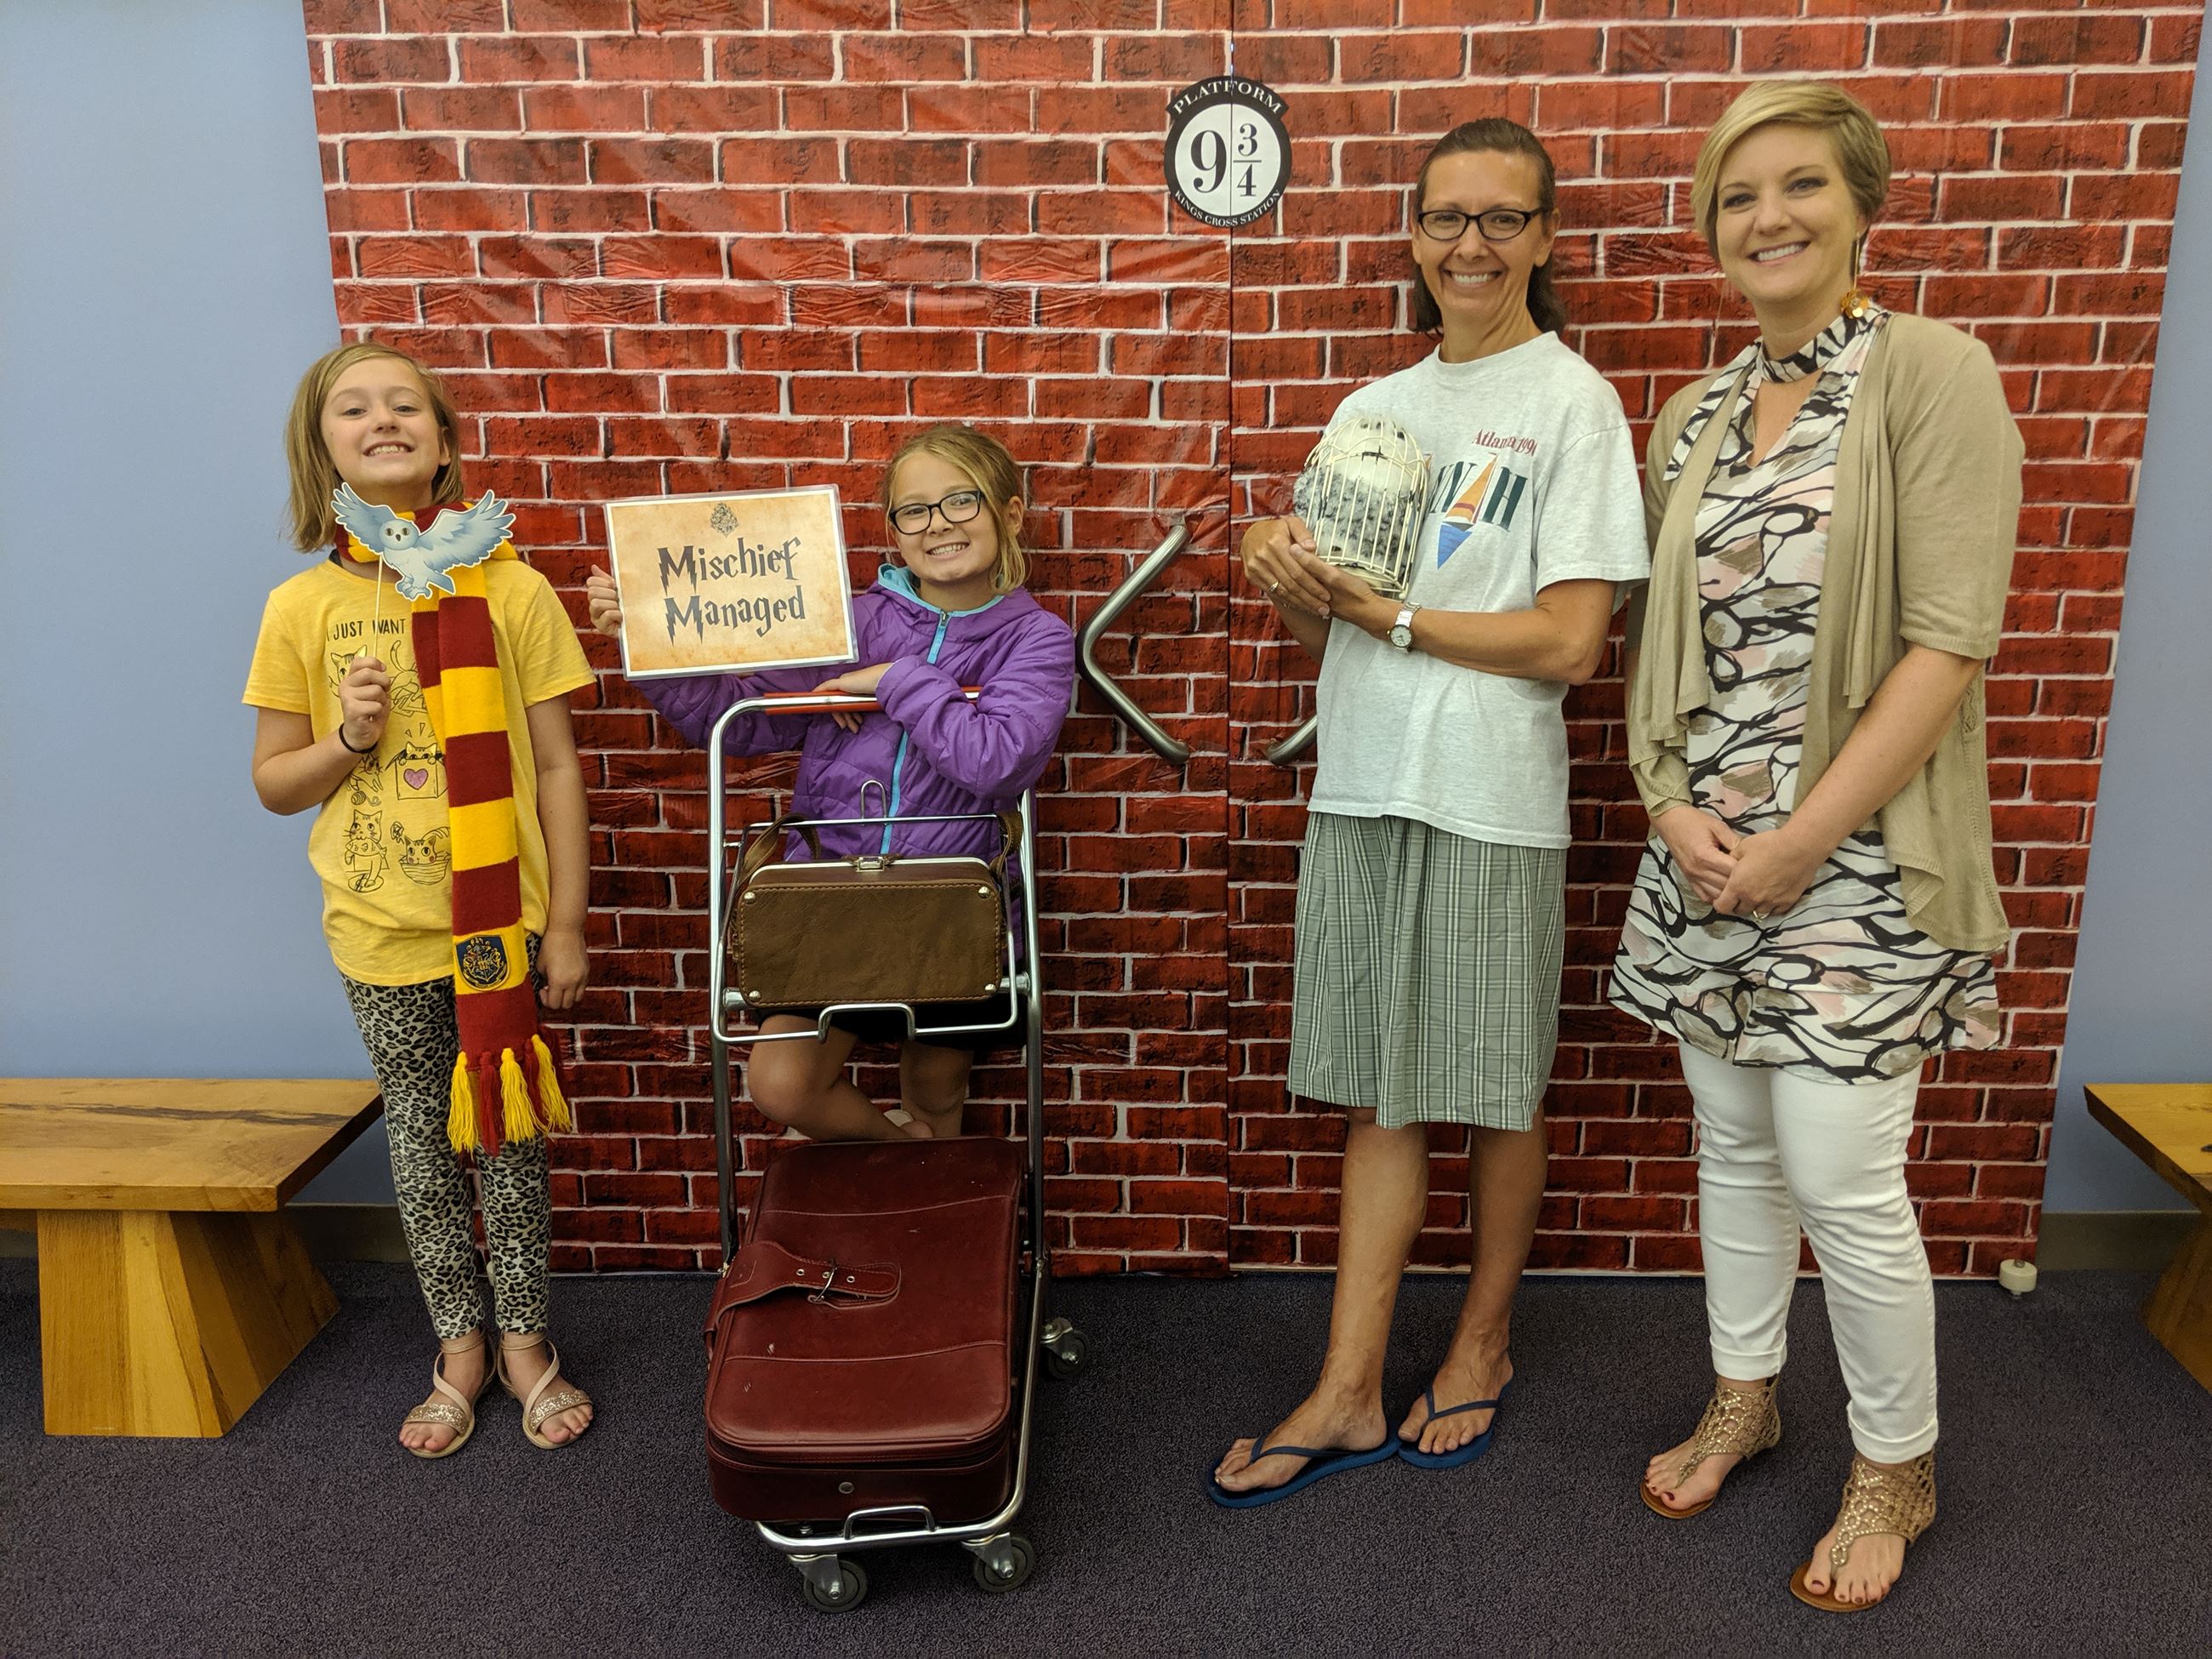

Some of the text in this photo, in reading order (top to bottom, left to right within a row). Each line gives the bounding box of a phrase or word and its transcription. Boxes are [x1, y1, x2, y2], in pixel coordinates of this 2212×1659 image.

[1172, 79, 1283, 116] PLATFORM
[1190, 129, 1227, 194] 9
[1175, 190, 1281, 227] KINGS CROSS STATION
[1471, 428, 1517, 449] Atlana
[657, 536, 801, 596] Mischief
[333, 620, 364, 641] JUST
[372, 619, 407, 635] WANT
[664, 584, 807, 647] Managed
